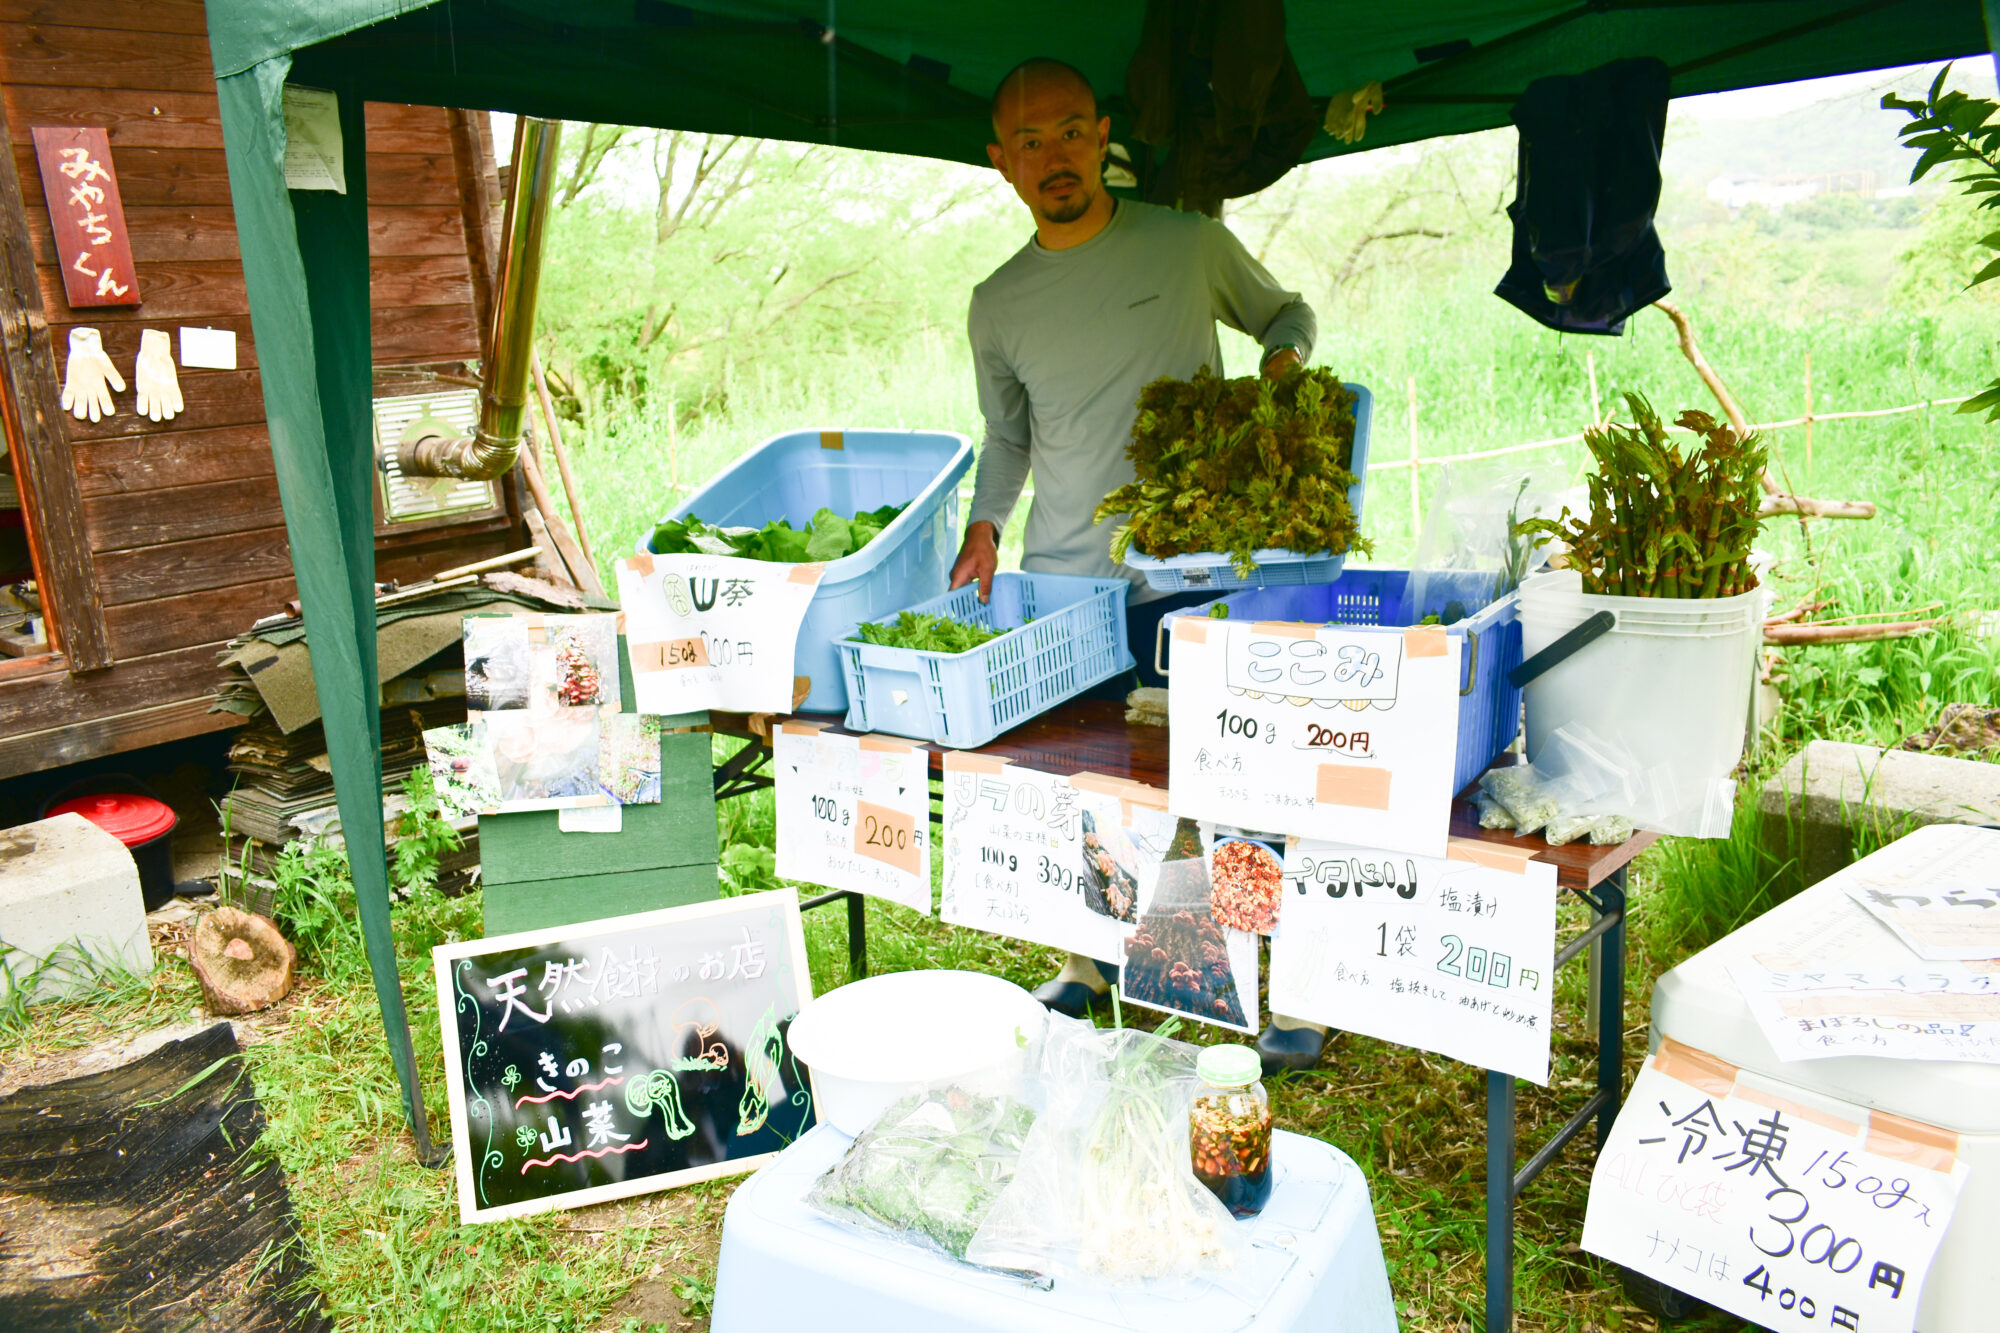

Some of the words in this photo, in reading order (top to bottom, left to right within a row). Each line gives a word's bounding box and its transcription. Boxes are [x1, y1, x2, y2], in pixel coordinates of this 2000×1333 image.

[1194, 747, 1243, 772] 食べ方
[1307, 722, 1371, 753] 200円
[1282, 857, 1418, 901] イタドリ
[986, 898, 1030, 925] 天ぷら
[1439, 887, 1498, 918] 塩漬け
[1333, 961, 1370, 986] 食べ方
[1376, 922, 1418, 958] 1袋
[1436, 934, 1540, 992] 200円
[536, 1042, 623, 1092] きのこ
[539, 1099, 631, 1153] 山菜
[1638, 1099, 1790, 1188] 冷凍
[1749, 1187, 1906, 1299] 300円
